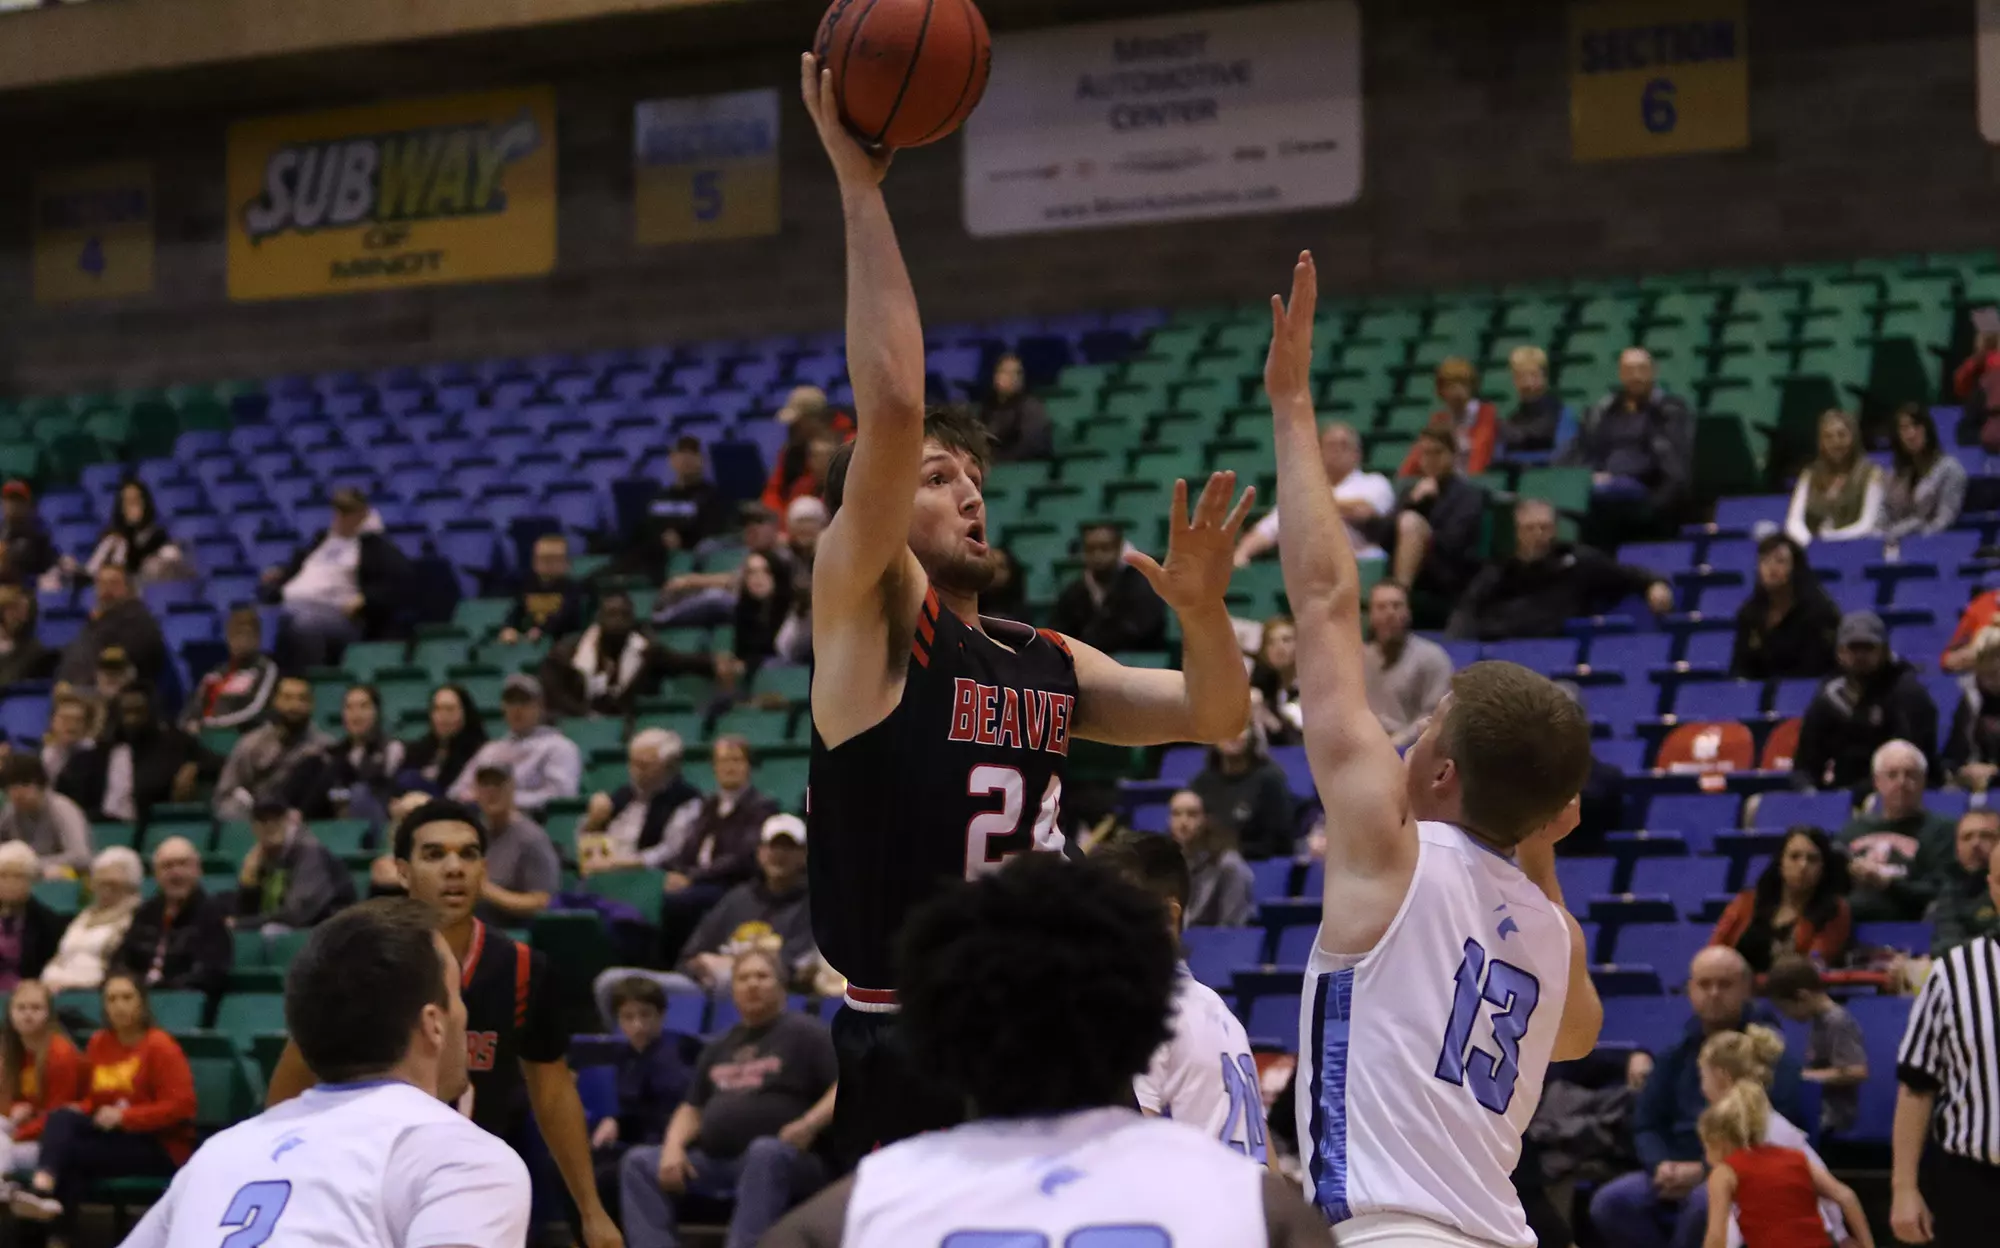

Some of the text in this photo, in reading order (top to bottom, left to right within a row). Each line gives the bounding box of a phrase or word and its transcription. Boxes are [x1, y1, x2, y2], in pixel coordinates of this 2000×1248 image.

[1075, 58, 1251, 99] AUTOMOTIVE
[1640, 77, 1677, 134] 6
[1108, 97, 1217, 131] CENTER
[242, 114, 537, 240] SUBWAY
[692, 169, 723, 221] 5
[1434, 936, 1540, 1115] 13
